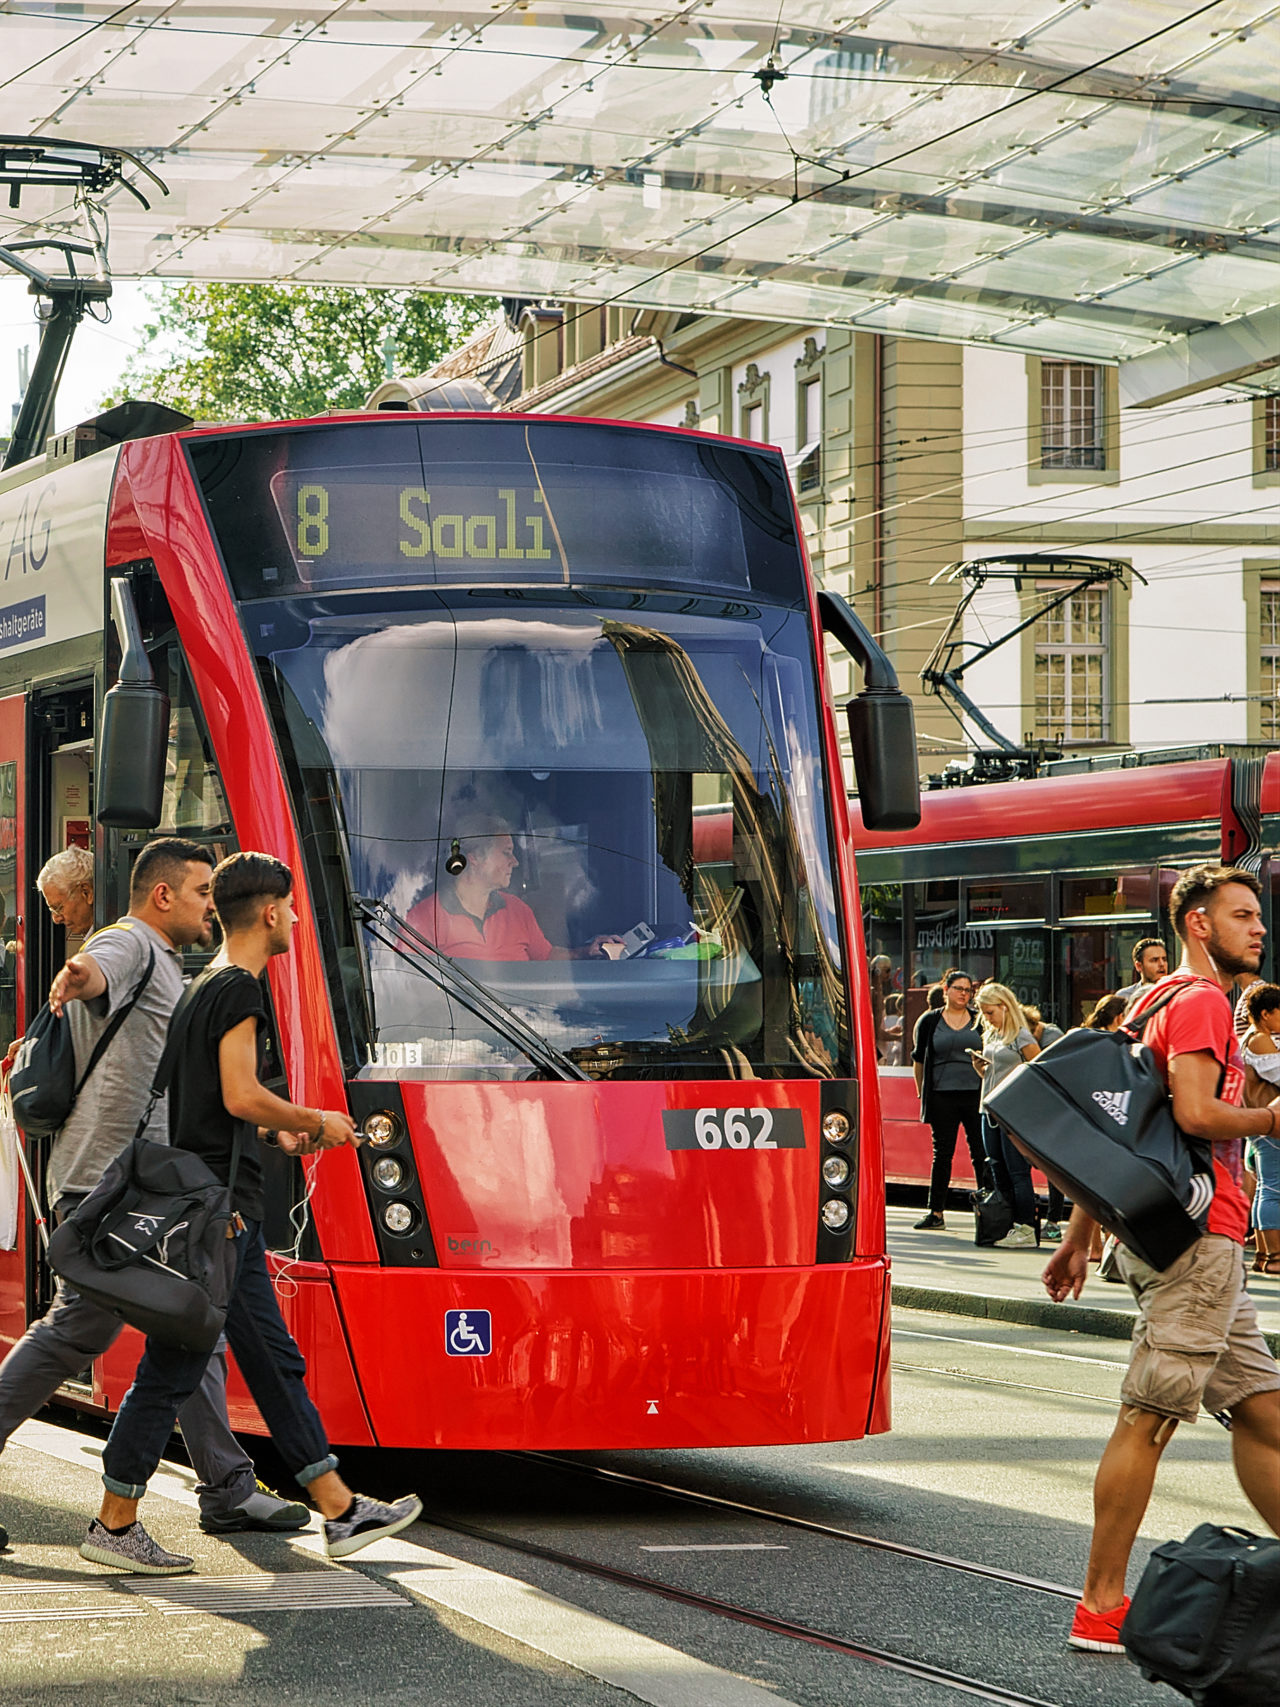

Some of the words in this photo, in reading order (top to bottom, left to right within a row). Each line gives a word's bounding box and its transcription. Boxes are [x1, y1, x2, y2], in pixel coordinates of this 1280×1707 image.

[5, 481, 57, 581] AG
[297, 485, 329, 557] 8
[399, 487, 552, 560] Saali
[693, 1107, 779, 1150] 662
[1091, 1091, 1129, 1126] adidas
[447, 1236, 492, 1252] bern
